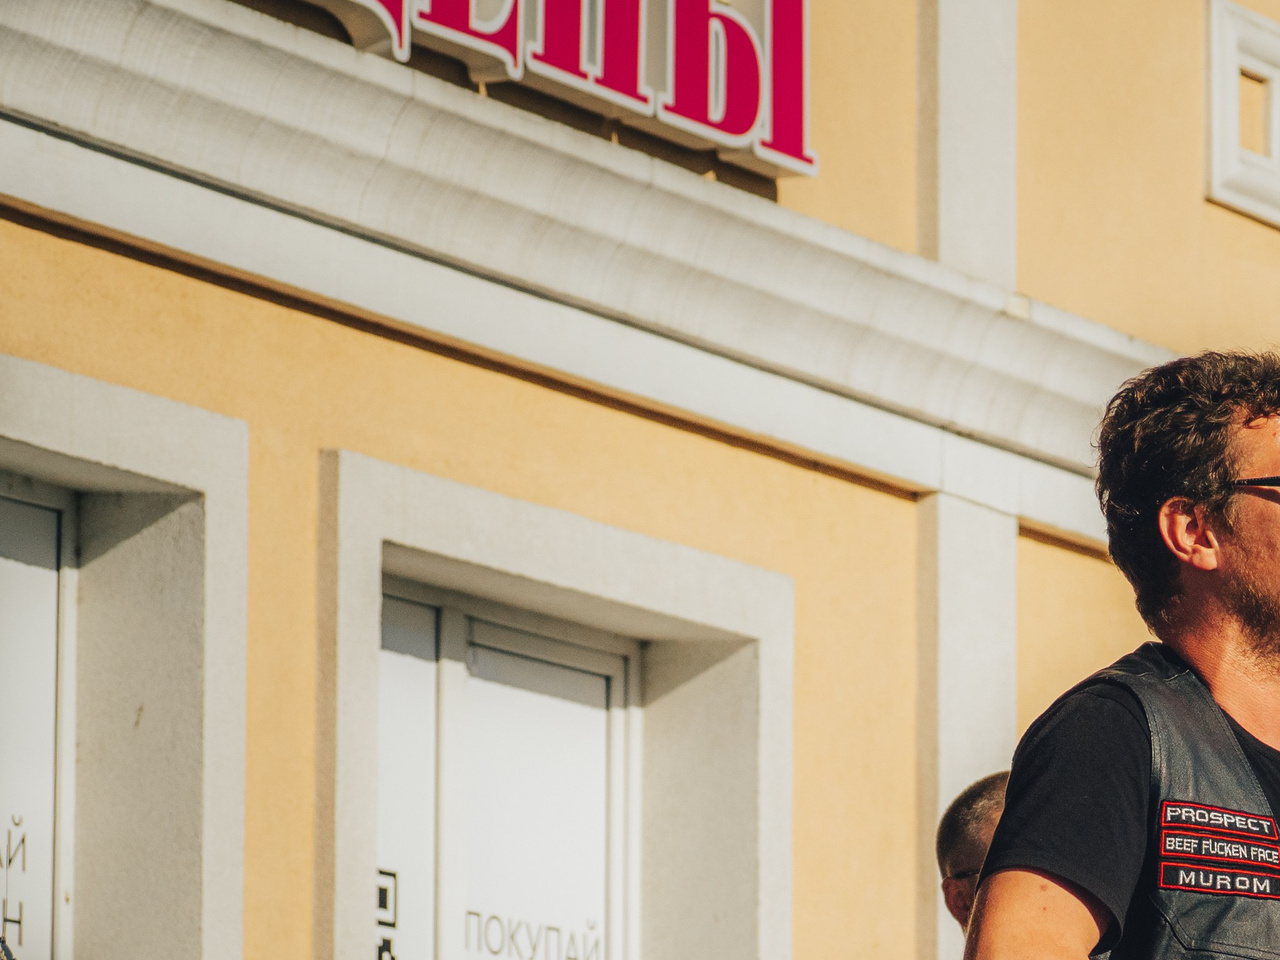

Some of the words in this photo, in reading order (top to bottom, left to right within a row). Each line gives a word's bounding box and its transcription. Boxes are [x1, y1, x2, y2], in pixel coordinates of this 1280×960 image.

[1166, 806, 1271, 834] PROSPECT
[1166, 837, 1199, 854] BEEF
[1202, 839, 1248, 860] FUCKEN
[1251, 846, 1280, 864] FACE
[1178, 869, 1271, 893] MUROM
